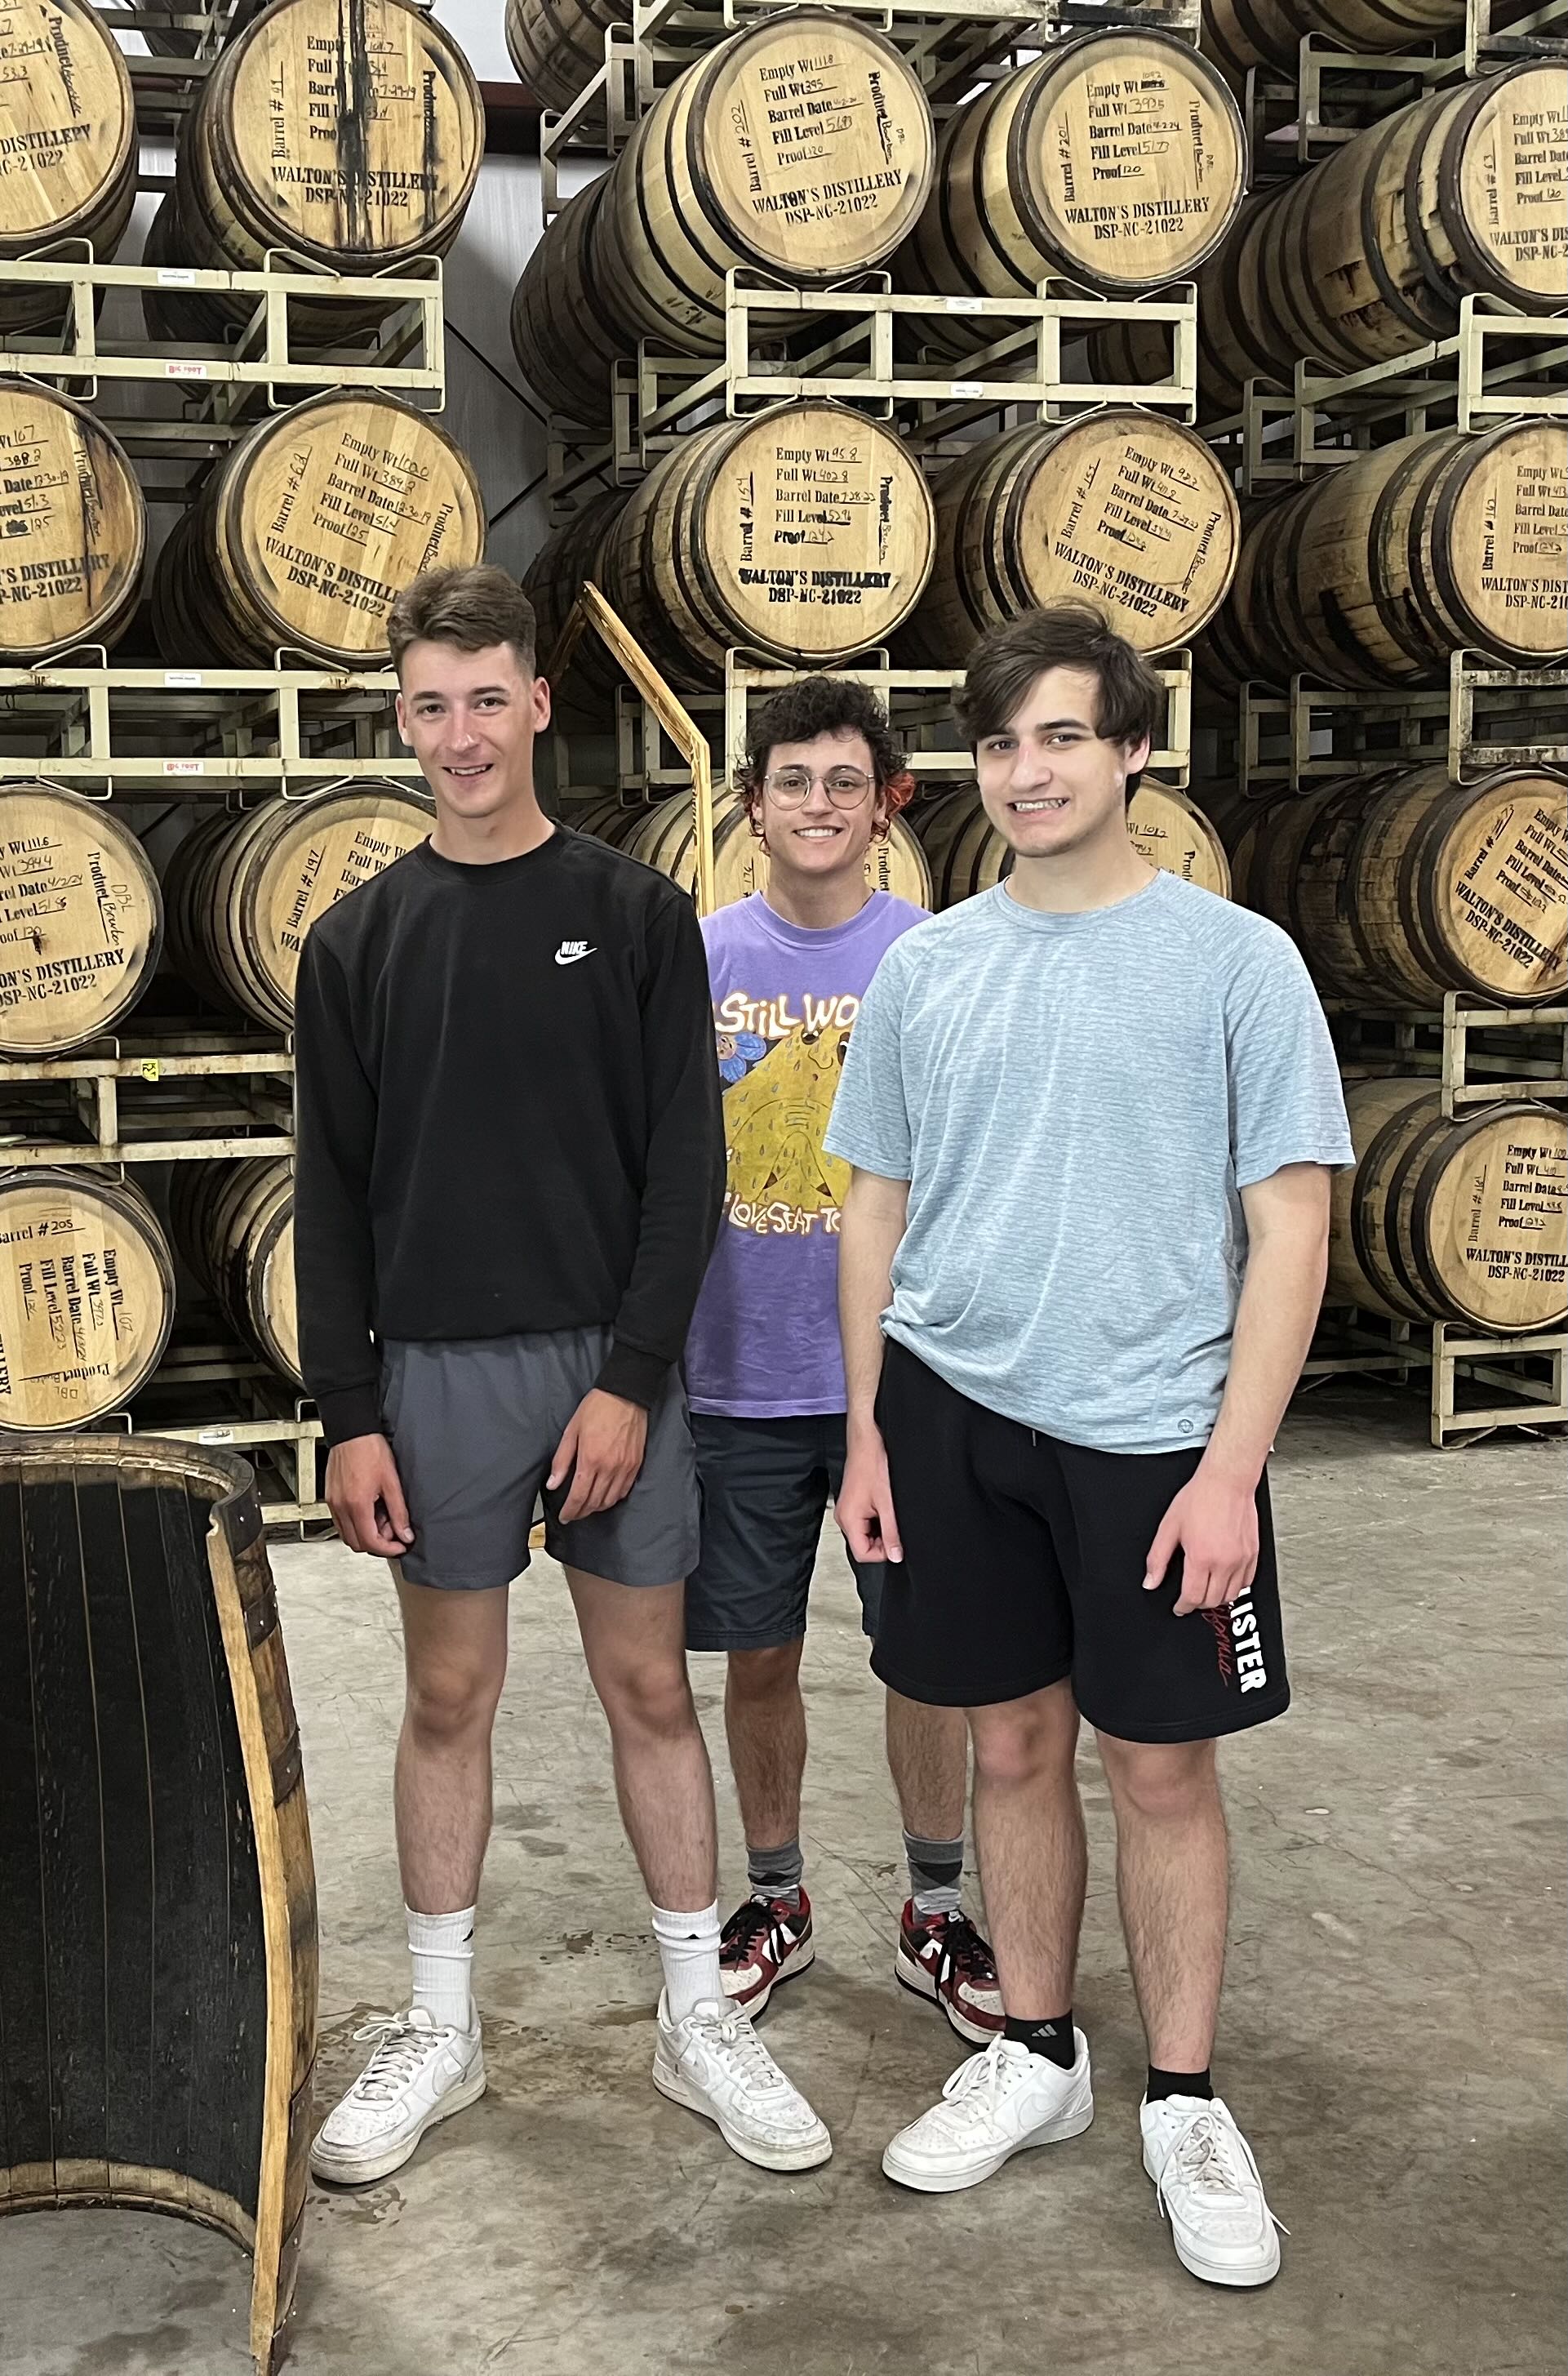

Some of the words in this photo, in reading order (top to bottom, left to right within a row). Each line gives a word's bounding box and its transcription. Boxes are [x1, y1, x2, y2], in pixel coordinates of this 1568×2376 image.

[308, 59, 332, 73] Full
[760, 65, 795, 82] Empty
[797, 60, 814, 73] Wt
[764, 86, 786, 102] Full
[789, 84, 806, 98] Wt
[868, 71, 888, 118] Product
[1086, 82, 1120, 98] Empty
[1124, 81, 1139, 93] Wt
[309, 103, 330, 118] Fill
[768, 105, 804, 123] Barrel
[807, 100, 833, 115] Date
[1088, 105, 1109, 118] Full
[1113, 103, 1128, 115] Wt
[1512, 113, 1544, 127] Empty
[772, 130, 792, 145] Fill
[795, 122, 824, 140] Level
[1089, 124, 1123, 139] Barrel
[1128, 122, 1153, 135] Date
[1189, 100, 1203, 146] Product
[270, 117, 286, 158] Barrel
[1514, 131, 1534, 145] Full
[777, 152, 808, 166] Proof
[1091, 145, 1110, 159] Fill
[1113, 143, 1143, 158] Level
[1515, 150, 1547, 165] Barrel
[743, 153, 762, 193] Barrel
[1061, 163, 1075, 202] Barrel
[1092, 164, 1122, 180] Proof
[1515, 171, 1532, 185] Fill
[1535, 169, 1563, 183] Level
[753, 187, 820, 214] WALTON'S
[824, 169, 903, 199] DISTILLERY
[1517, 193, 1544, 205] Proof
[785, 193, 878, 227] DSP-NC-21022
[1065, 205, 1129, 225] WALTON'S
[1134, 197, 1209, 218] DISTILLERY
[1486, 189, 1499, 225] Barrel
[1095, 217, 1184, 240] DSP-NC-21022
[1490, 229, 1548, 247] WALTON'S
[341, 433, 381, 461] Empty
[383, 451, 399, 468] Wt
[776, 447, 812, 463] Empty
[815, 449, 829, 462] Wt
[1125, 446, 1158, 472] Empty
[335, 452, 359, 474] Full
[362, 465, 379, 482] Wt
[776, 469, 798, 481] Full
[802, 470, 817, 482] Wt
[1118, 465, 1140, 485] Full
[1517, 465, 1548, 482] Empty
[4, 477, 33, 494] Date
[326, 474, 366, 498] Barrel
[367, 490, 395, 513] Date
[775, 489, 811, 502] Barrel
[816, 491, 840, 504] Date
[1517, 484, 1535, 497] Full
[320, 492, 341, 511] Fill
[344, 501, 375, 526] Level
[1110, 483, 1143, 508] Barrel
[1145, 499, 1169, 518] Date
[1515, 504, 1545, 516] Barrel
[271, 493, 295, 533] Barrel
[313, 513, 346, 535] Proof
[775, 509, 794, 523] Fill
[798, 510, 828, 524] Level
[1061, 501, 1083, 539] Barrel
[1104, 502, 1122, 519] Fill
[1124, 510, 1150, 531] Level
[428, 503, 454, 551] Product
[775, 530, 806, 545] Proof
[1197, 512, 1221, 555] Product
[1514, 523, 1531, 536] Fill
[1533, 523, 1557, 536] Level
[740, 522, 753, 561] Barrel
[1482, 534, 1495, 570] Barrel
[1513, 541, 1538, 554] Proof
[265, 537, 335, 577] WALTON'S
[739, 568, 807, 585] WALTON'S
[811, 571, 891, 588] DISTILLERY
[1054, 542, 1116, 579] WALTON'S
[1117, 570, 1190, 613] DISTILLERY
[1481, 577, 1539, 593] WALTON'S
[287, 565, 387, 618] DSP-NC-21022
[769, 588, 862, 605] DSP-NC-21022
[1073, 570, 1158, 617] DSP-NC-21022
[1534, 808, 1561, 838] Empty
[354, 831, 392, 857] Empty
[1524, 824, 1544, 846] Full
[8, 841, 27, 857] Wt
[347, 850, 372, 870] Full
[1515, 839, 1543, 867] Barrel
[1542, 860, 1562, 882] Date
[87, 852, 109, 899] Product
[1464, 848, 1489, 880] Barrel
[1505, 854, 1523, 874] Fill
[1520, 866, 1546, 891] Level
[18, 881, 47, 898] Date
[286, 889, 310, 928] Barrel
[305, 849, 320, 872] 197
[1495, 870, 1521, 893] Proof
[4, 902, 38, 923] Level
[1455, 880, 1503, 926] WALTON'S
[561, 941, 588, 954] NIKE
[1464, 909, 1535, 970] DSP-NC-21022
[37, 948, 125, 981] DISTILLERY
[804, 994, 861, 1036] WO
[1508, 1145, 1537, 1159] Empty
[1505, 1162, 1523, 1174] Full
[1503, 1180, 1532, 1194] Barrel
[1535, 1182, 1557, 1195] Date
[1500, 1199, 1517, 1210] Fill
[1519, 1199, 1544, 1212] Level
[1468, 1208, 1482, 1242] Barrel
[1499, 1216, 1524, 1228] Proof
[82, 1253, 98, 1278] Full
[104, 1248, 118, 1287] Empty
[1466, 1248, 1521, 1265] WALTON'S
[20, 1262, 34, 1295] Proof
[40, 1258, 59, 1282] Fill
[61, 1255, 80, 1294] Barrel
[1487, 1266, 1566, 1282] DSP-NC-21022
[43, 1283, 61, 1315] Level
[68, 1296, 82, 1324] Date
[64, 1363, 110, 1382] Product
